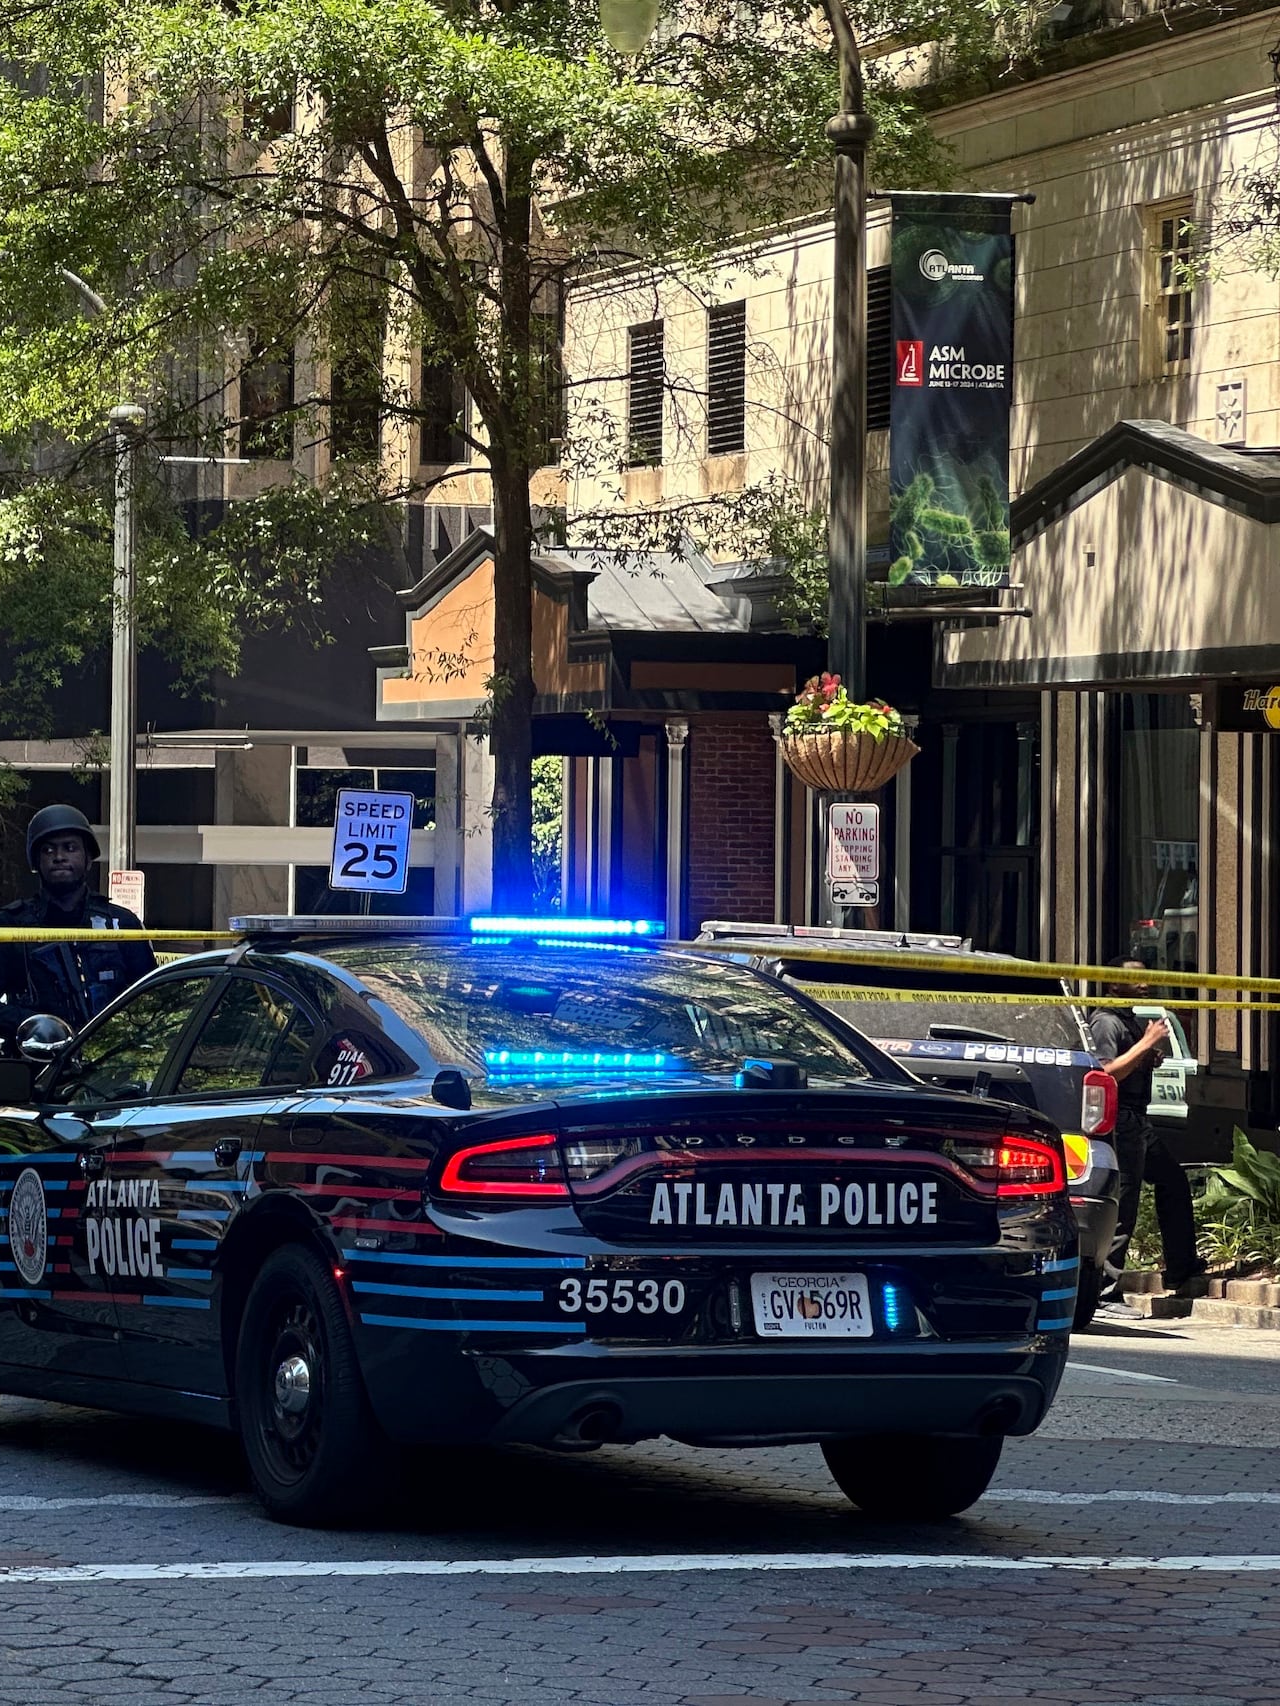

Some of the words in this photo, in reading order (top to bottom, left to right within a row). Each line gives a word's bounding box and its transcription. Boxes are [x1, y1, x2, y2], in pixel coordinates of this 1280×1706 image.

[929, 264, 975, 275] ATLANTA
[928, 345, 965, 362] ASM
[928, 364, 1005, 381] MICROBE
[928, 380, 944, 388] JUNE
[977, 381, 1005, 389] ATLANTA
[1242, 689, 1280, 711] Har
[344, 802, 405, 819] SPEED
[845, 811, 863, 825] NO
[348, 822, 397, 839] LIMIT
[834, 827, 875, 841] PARKING
[835, 845, 873, 853] STOPPING
[340, 842, 398, 879] 25
[835, 854, 873, 863] STANDING
[838, 864, 851, 872] ANY
[855, 864, 870, 872] TIME
[337, 1050, 364, 1063] DIAL
[963, 1043, 1072, 1066] POLICE
[327, 1063, 360, 1085] 911
[686, 1137, 902, 1147] DODGE
[86, 1179, 161, 1207] ATLANTA
[650, 1182, 805, 1226] ATLANTA
[820, 1182, 937, 1225] POLICE
[86, 1218, 164, 1277] POLICE
[776, 1276, 840, 1288] GEORGIA
[558, 1278, 686, 1314] 35530
[770, 1290, 863, 1320] GV1569R
[804, 1321, 827, 1330] FULTON
